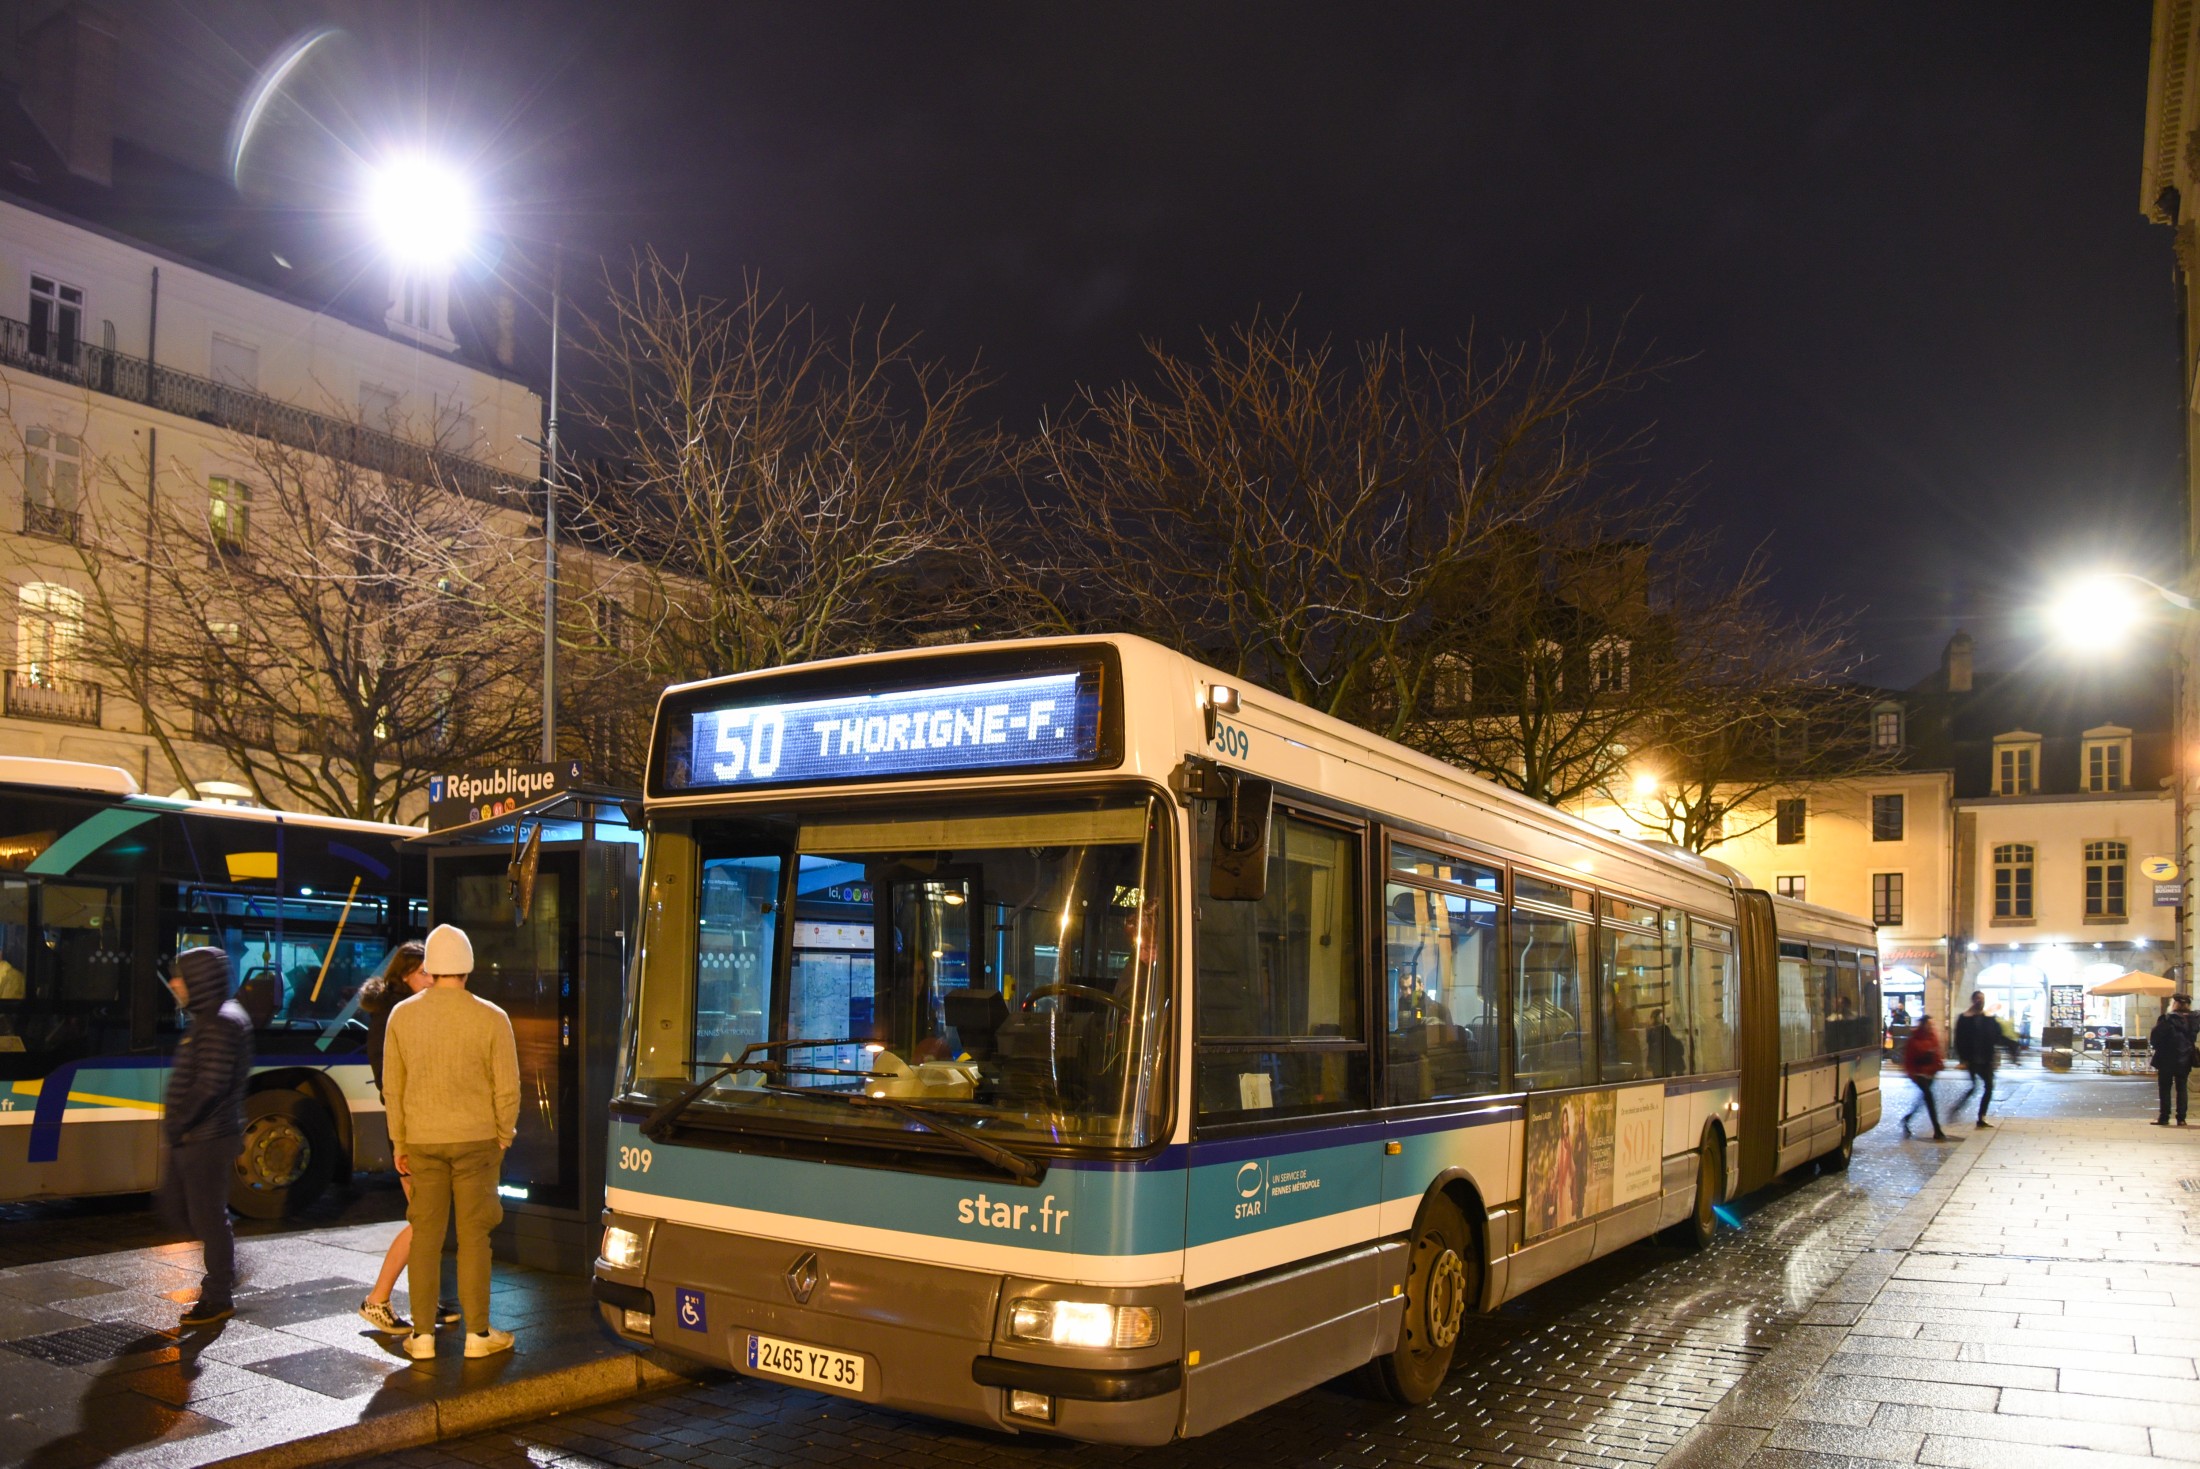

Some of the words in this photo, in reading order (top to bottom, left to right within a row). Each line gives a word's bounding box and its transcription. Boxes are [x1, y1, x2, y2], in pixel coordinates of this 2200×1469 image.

[712, 710, 785, 781] 50
[813, 700, 1065, 756] THORIGNE-F.
[1215, 721, 1249, 761] 309
[432, 784, 441, 802] J
[447, 768, 555, 803] République
[618, 1145, 653, 1173] 309
[1271, 1184, 1292, 1197] RENNES
[1292, 1179, 1320, 1191] MÉTROPOLE
[1272, 1174, 1281, 1184] UN
[1280, 1170, 1300, 1183] SERVICE
[1300, 1169, 1307, 1179] DE
[957, 1193, 1070, 1235] star.fr
[1234, 1200, 1262, 1220] STAR
[762, 1343, 803, 1374] 2465
[808, 1352, 829, 1380] YZ
[834, 1357, 856, 1385] 35
